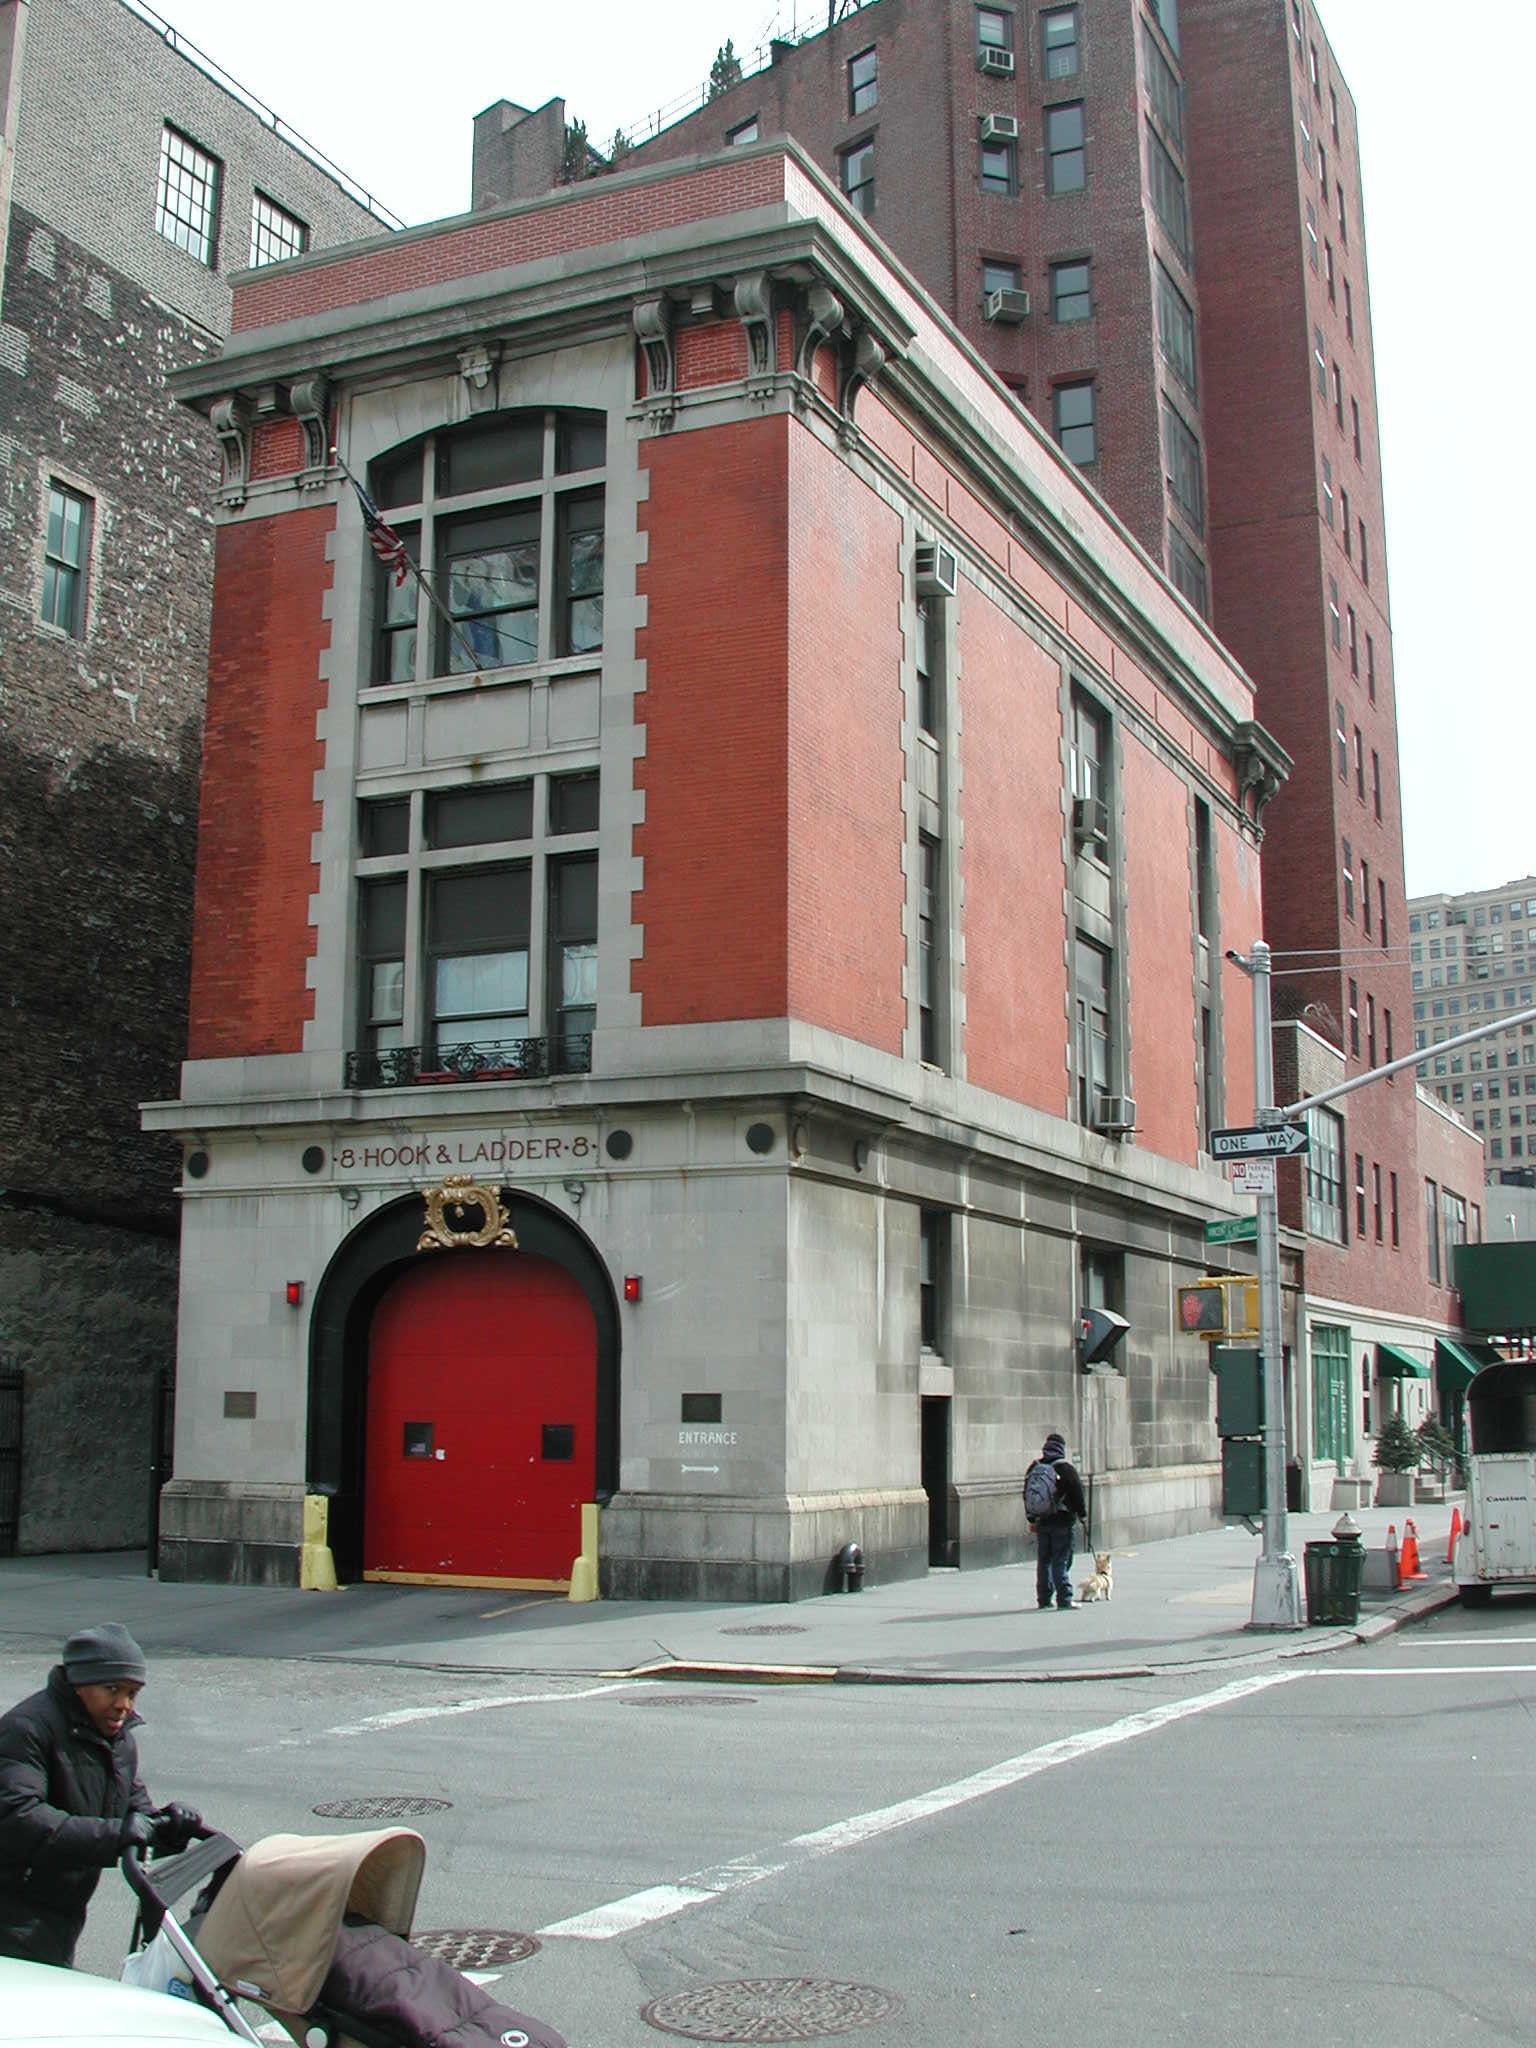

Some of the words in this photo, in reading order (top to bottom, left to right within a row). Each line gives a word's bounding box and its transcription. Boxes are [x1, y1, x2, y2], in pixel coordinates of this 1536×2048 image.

[1220, 1137, 1248, 1151] ONE
[1266, 1132, 1295, 1146] WAY
[340, 1149, 355, 1168] 8
[364, 1145, 430, 1168] HOOK
[436, 1145, 452, 1164] &
[458, 1138, 561, 1163] LADDER
[572, 1136, 589, 1158] 8
[1232, 1164, 1245, 1176] NO
[679, 1431, 737, 1445] ENTRANCE
